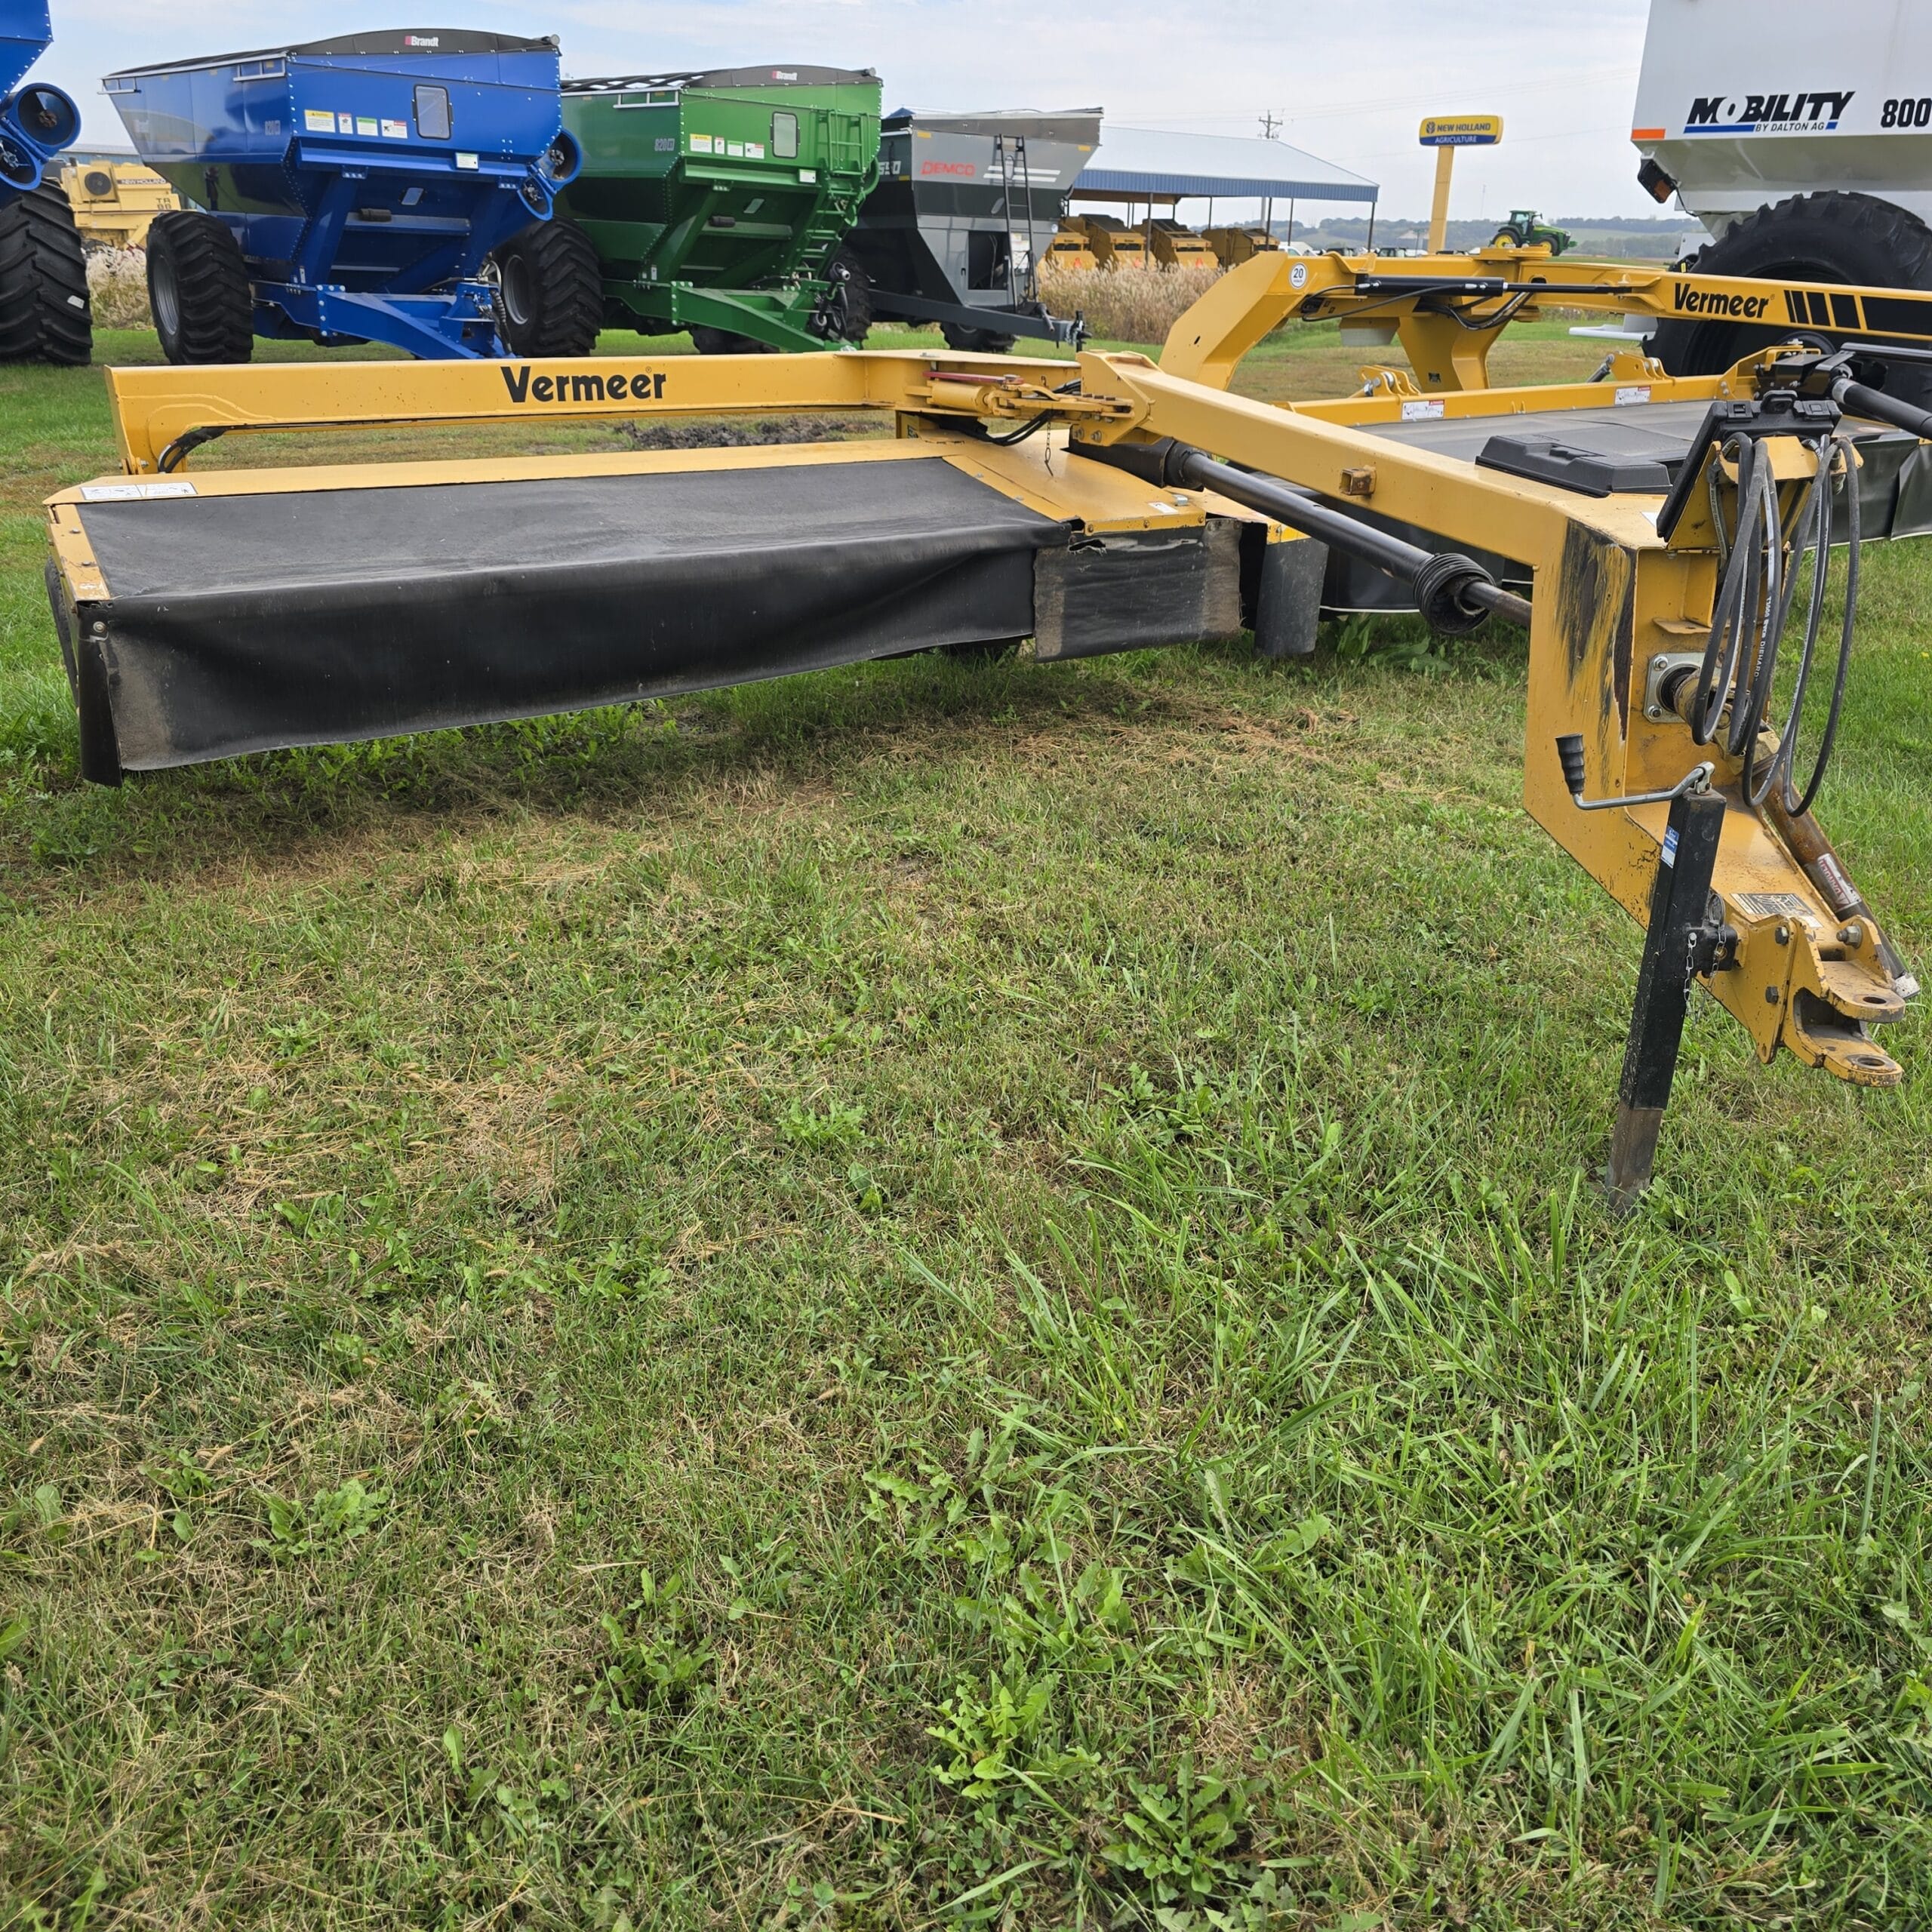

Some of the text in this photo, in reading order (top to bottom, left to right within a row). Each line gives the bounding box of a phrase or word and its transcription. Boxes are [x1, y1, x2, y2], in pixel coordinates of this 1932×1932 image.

[411, 35, 439, 48] Brandt
[1687, 91, 1857, 125] MOBILITY
[1437, 122, 1491, 132] NEW HOLLAND
[1755, 122, 1825, 132] BY DALTON AG
[920, 159, 976, 177] DEMCO
[1294, 268, 1303, 278] 20
[1675, 282, 1770, 318] Vermeer
[500, 366, 666, 403] Vermeer
[1754, 641, 1766, 678] DIEHARD
